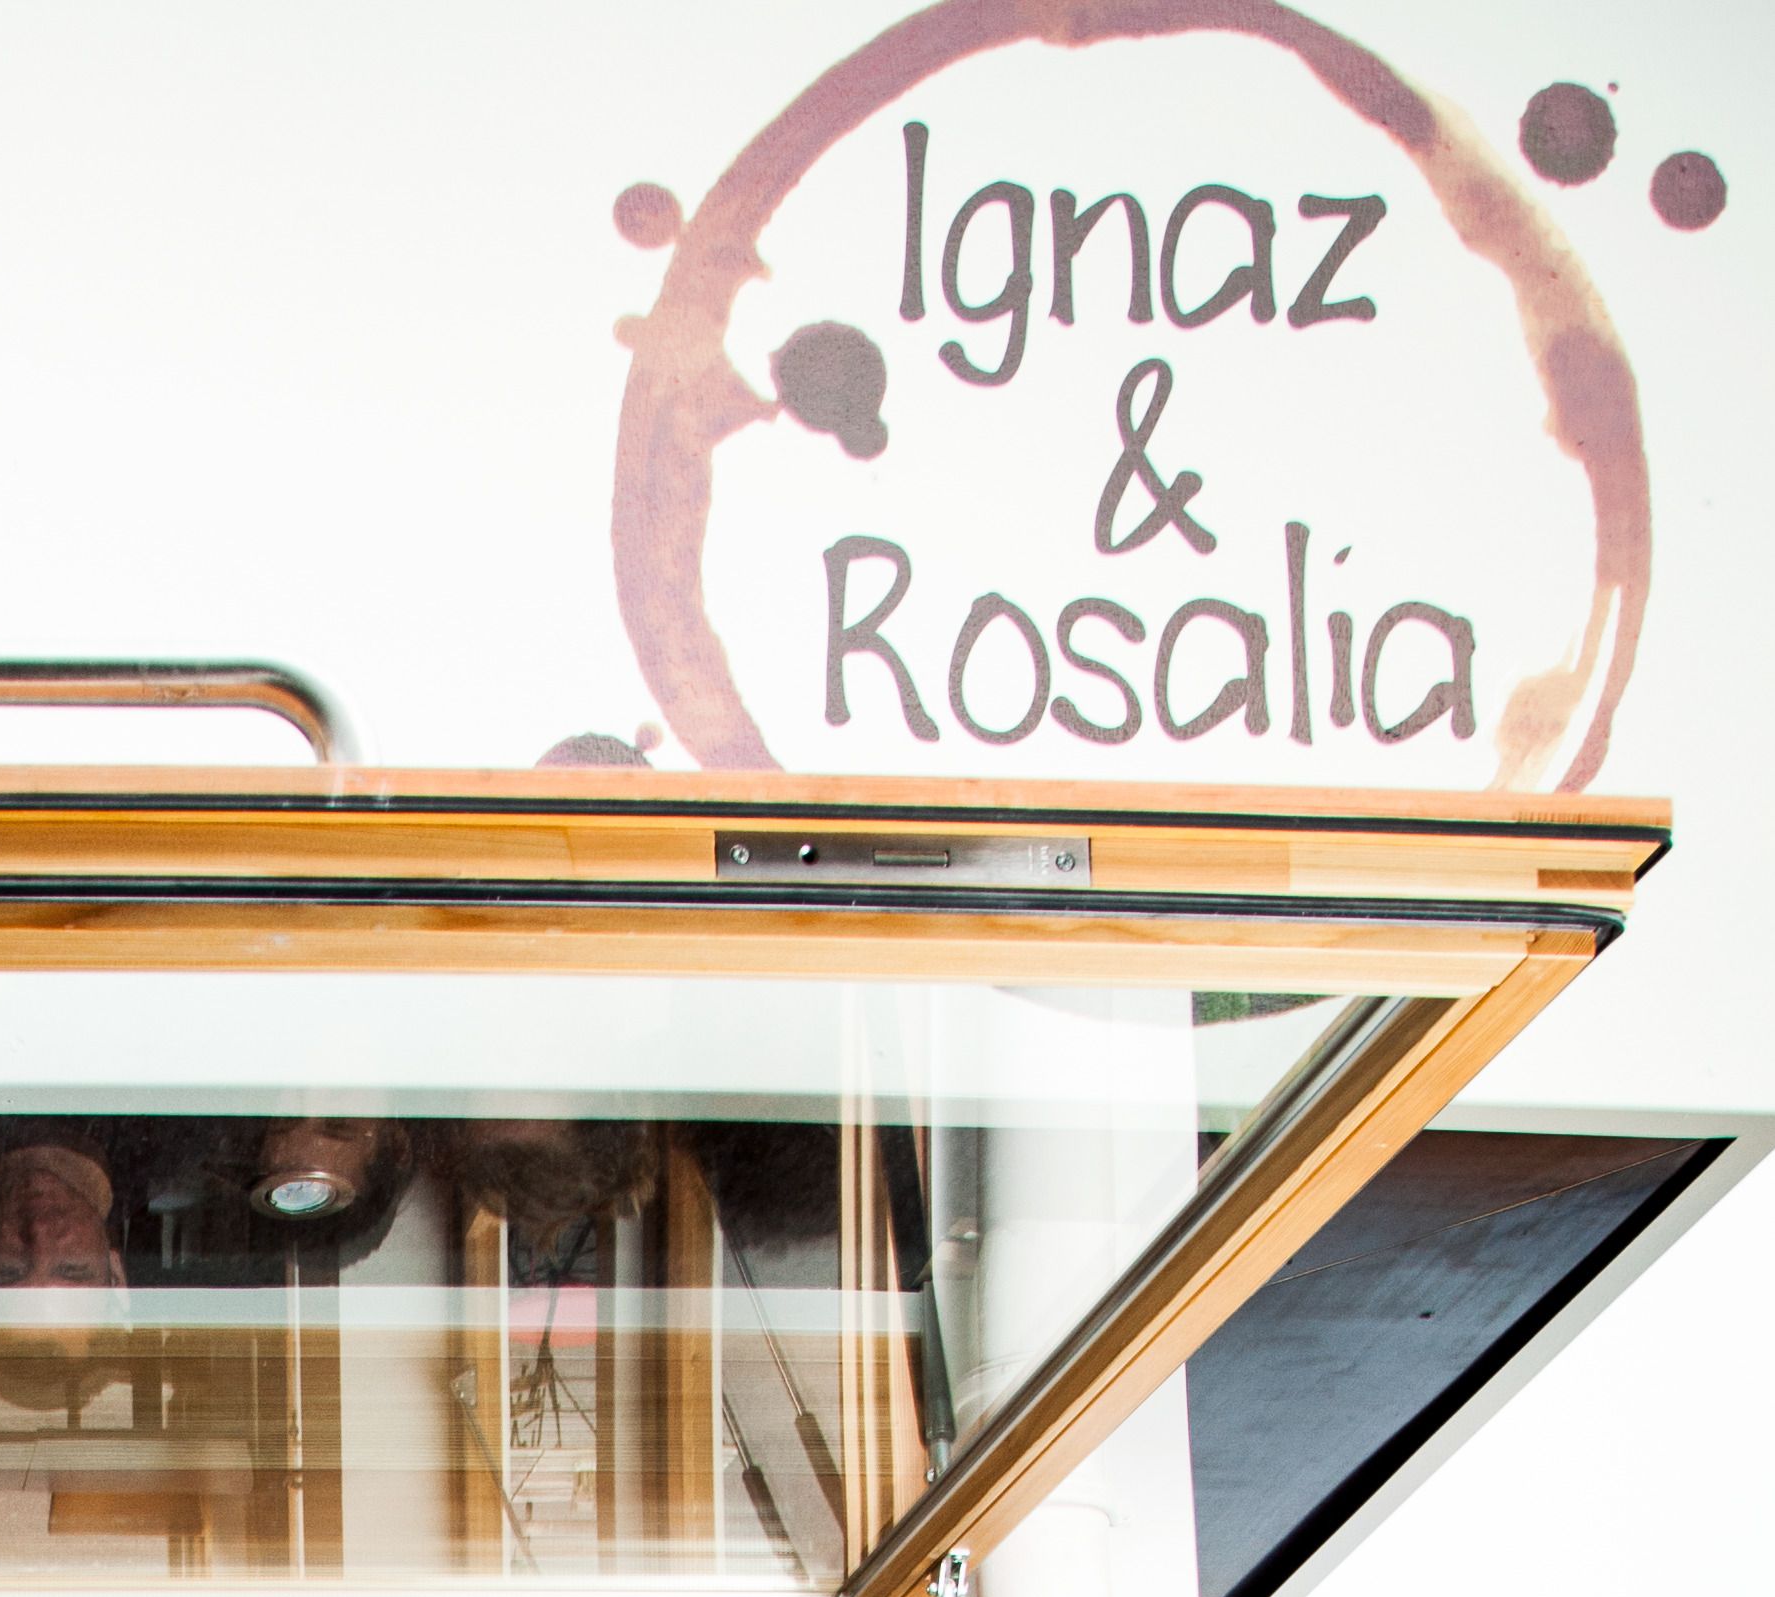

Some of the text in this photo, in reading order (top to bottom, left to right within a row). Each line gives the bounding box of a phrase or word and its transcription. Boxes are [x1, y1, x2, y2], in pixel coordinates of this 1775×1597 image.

[897, 120, 1388, 387] Ignaz
[1093, 357, 1218, 555] &
[822, 520, 1477, 747] Rosalia
